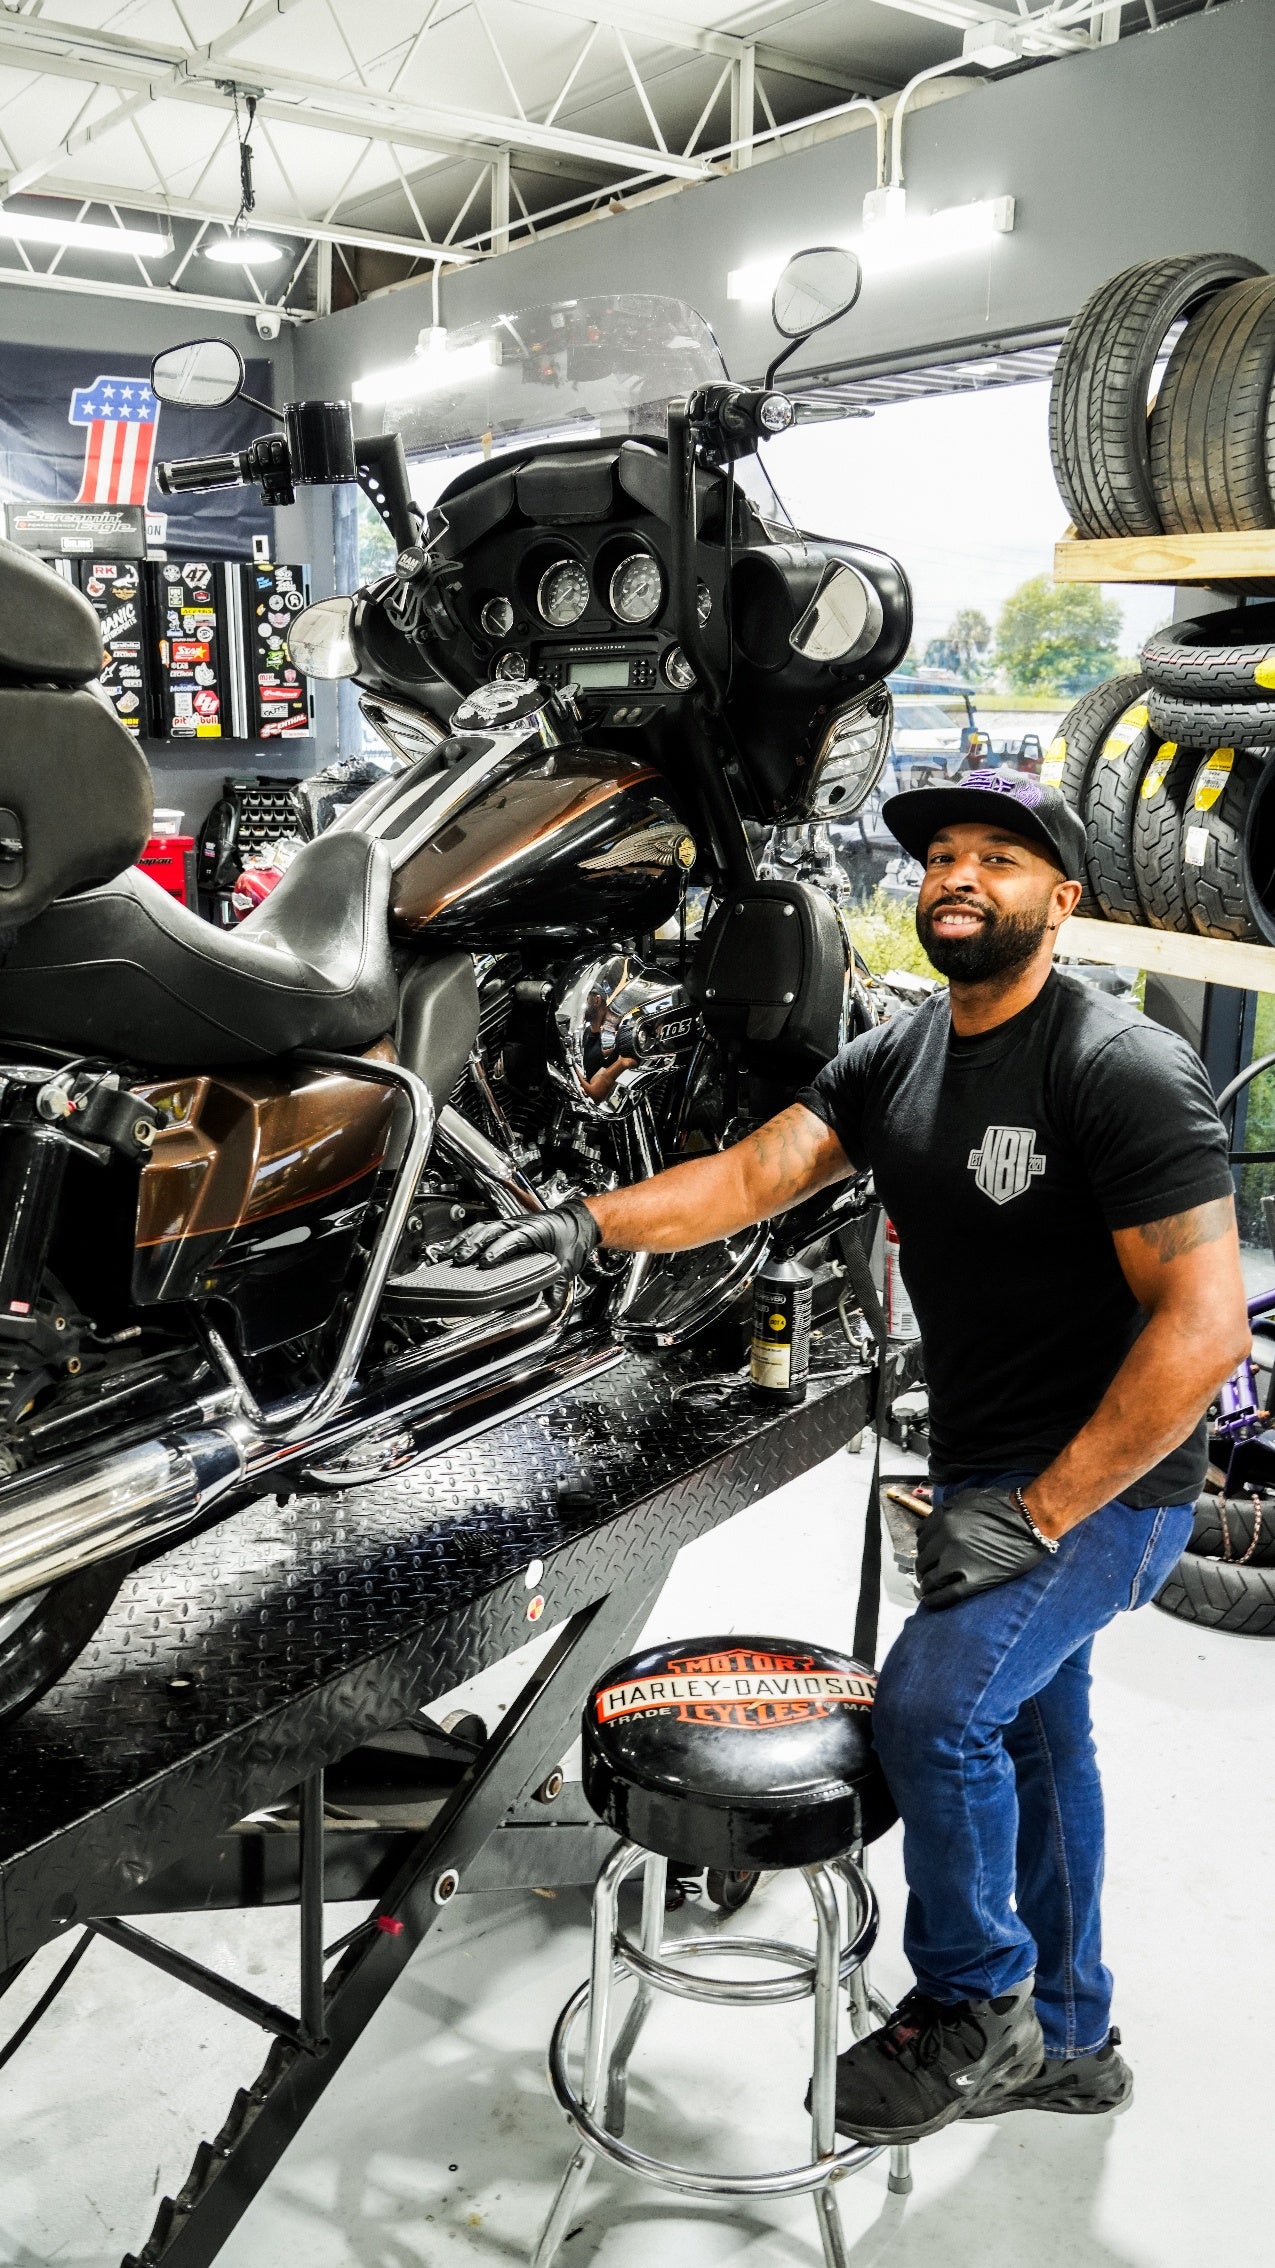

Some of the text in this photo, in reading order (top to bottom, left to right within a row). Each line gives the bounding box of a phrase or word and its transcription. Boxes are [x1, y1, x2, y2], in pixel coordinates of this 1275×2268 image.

[16, 510, 124, 524] Screamin'
[398, 553, 420, 571] RAM
[95, 567, 115, 575] RK
[185, 567, 208, 582] 47
[138, 857, 173, 866] nap-on
[660, 1018, 693, 1041] 103
[607, 1707, 672, 1728] TRADE
[694, 1700, 809, 1722] CYCLES
